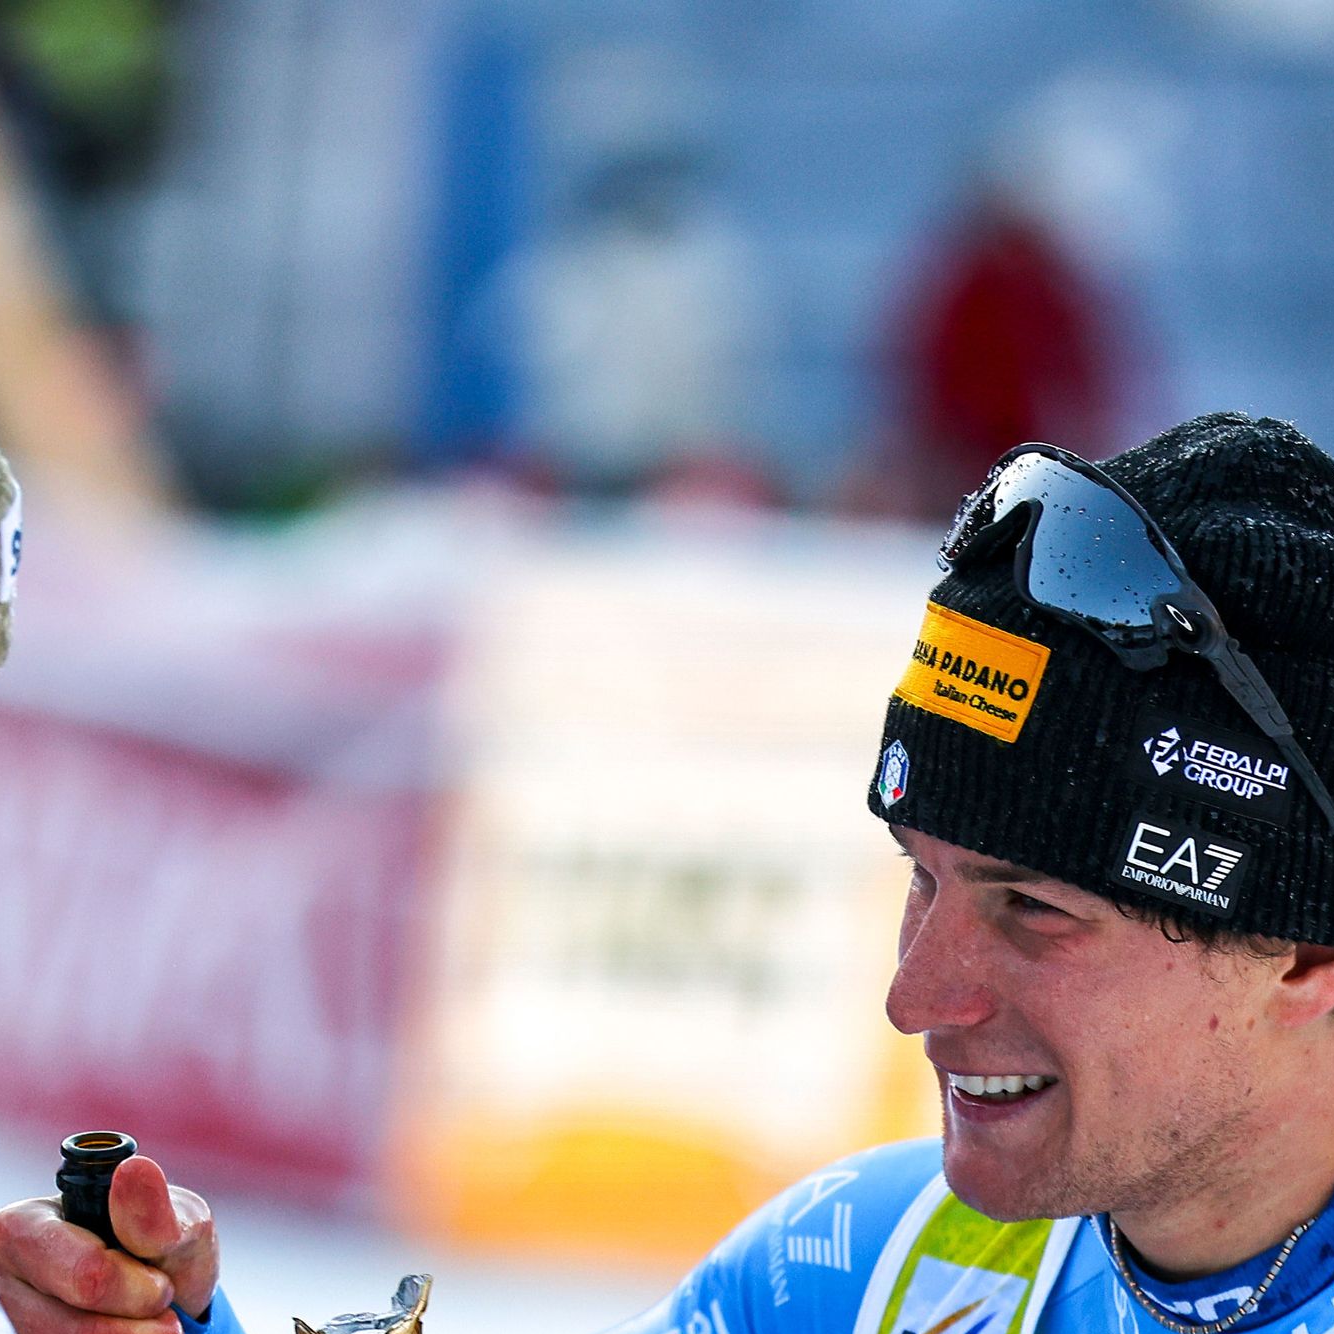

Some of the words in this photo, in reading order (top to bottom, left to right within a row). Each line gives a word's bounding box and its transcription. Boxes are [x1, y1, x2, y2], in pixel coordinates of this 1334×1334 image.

[939, 650, 1030, 702] PADANO
[933, 679, 968, 705] Italian
[969, 694, 1019, 723] Cheese
[1183, 763, 1264, 800] GROUP
[1189, 740, 1289, 785] FERALPI
[1121, 865, 1175, 892] EMPORIO
[1125, 822, 1244, 891] EA7
